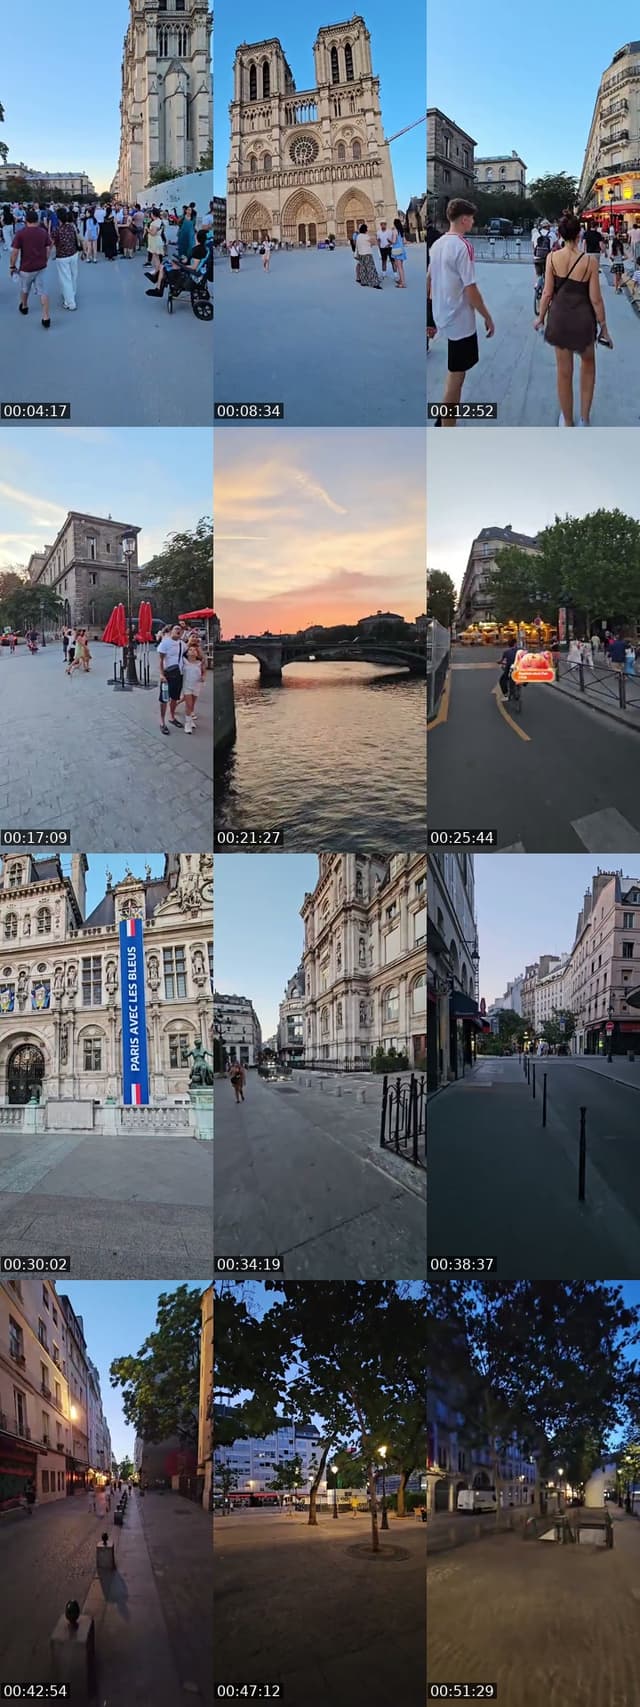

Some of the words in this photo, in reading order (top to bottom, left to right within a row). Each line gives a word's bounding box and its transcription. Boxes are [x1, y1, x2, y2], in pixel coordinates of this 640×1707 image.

[127, 946, 137, 980] BLEUS
[128, 983, 138, 1003] LES
[129, 1005, 140, 1036] AVEC
[130, 1038, 140, 1072] PARIS
